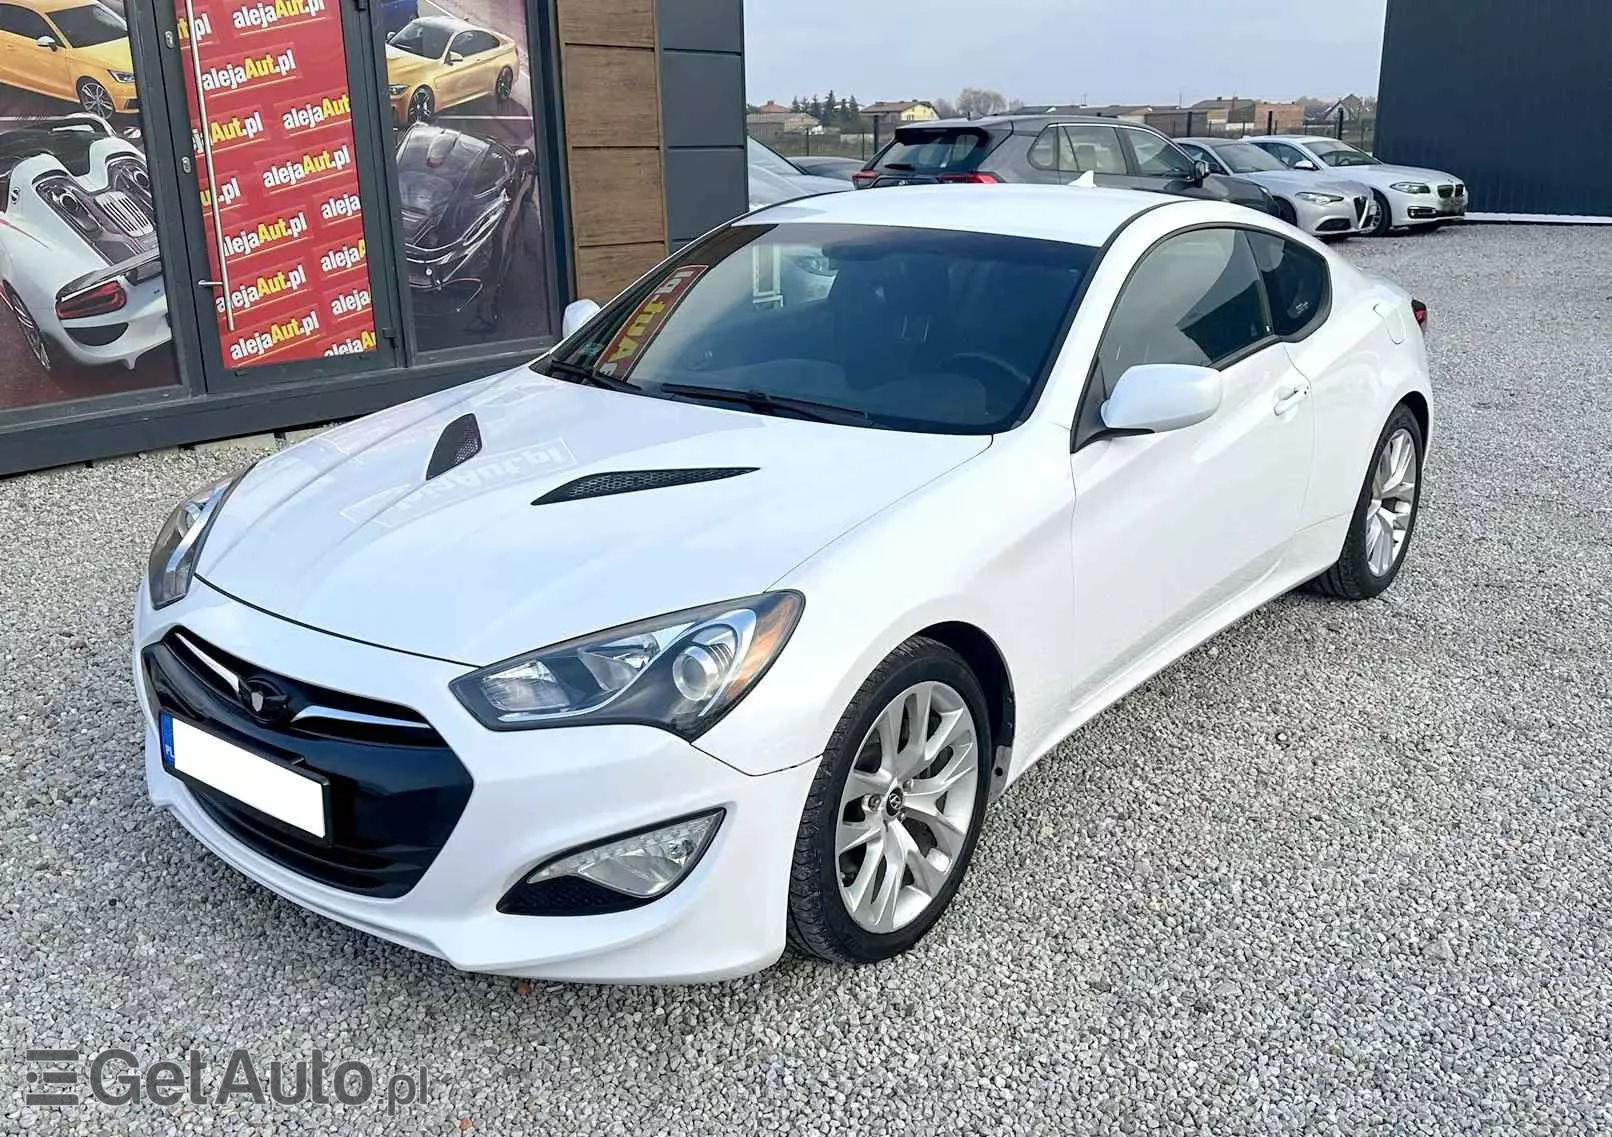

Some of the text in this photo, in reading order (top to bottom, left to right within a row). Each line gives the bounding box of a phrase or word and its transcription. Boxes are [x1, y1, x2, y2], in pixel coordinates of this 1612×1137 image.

[201, 50, 296, 91] alejaAut.pl
[282, 95, 351, 130] alejaAut
[262, 145, 351, 188] alejaAut.pl
[320, 193, 361, 220] aleja
[230, 311, 320, 361] alejaAut.pl
